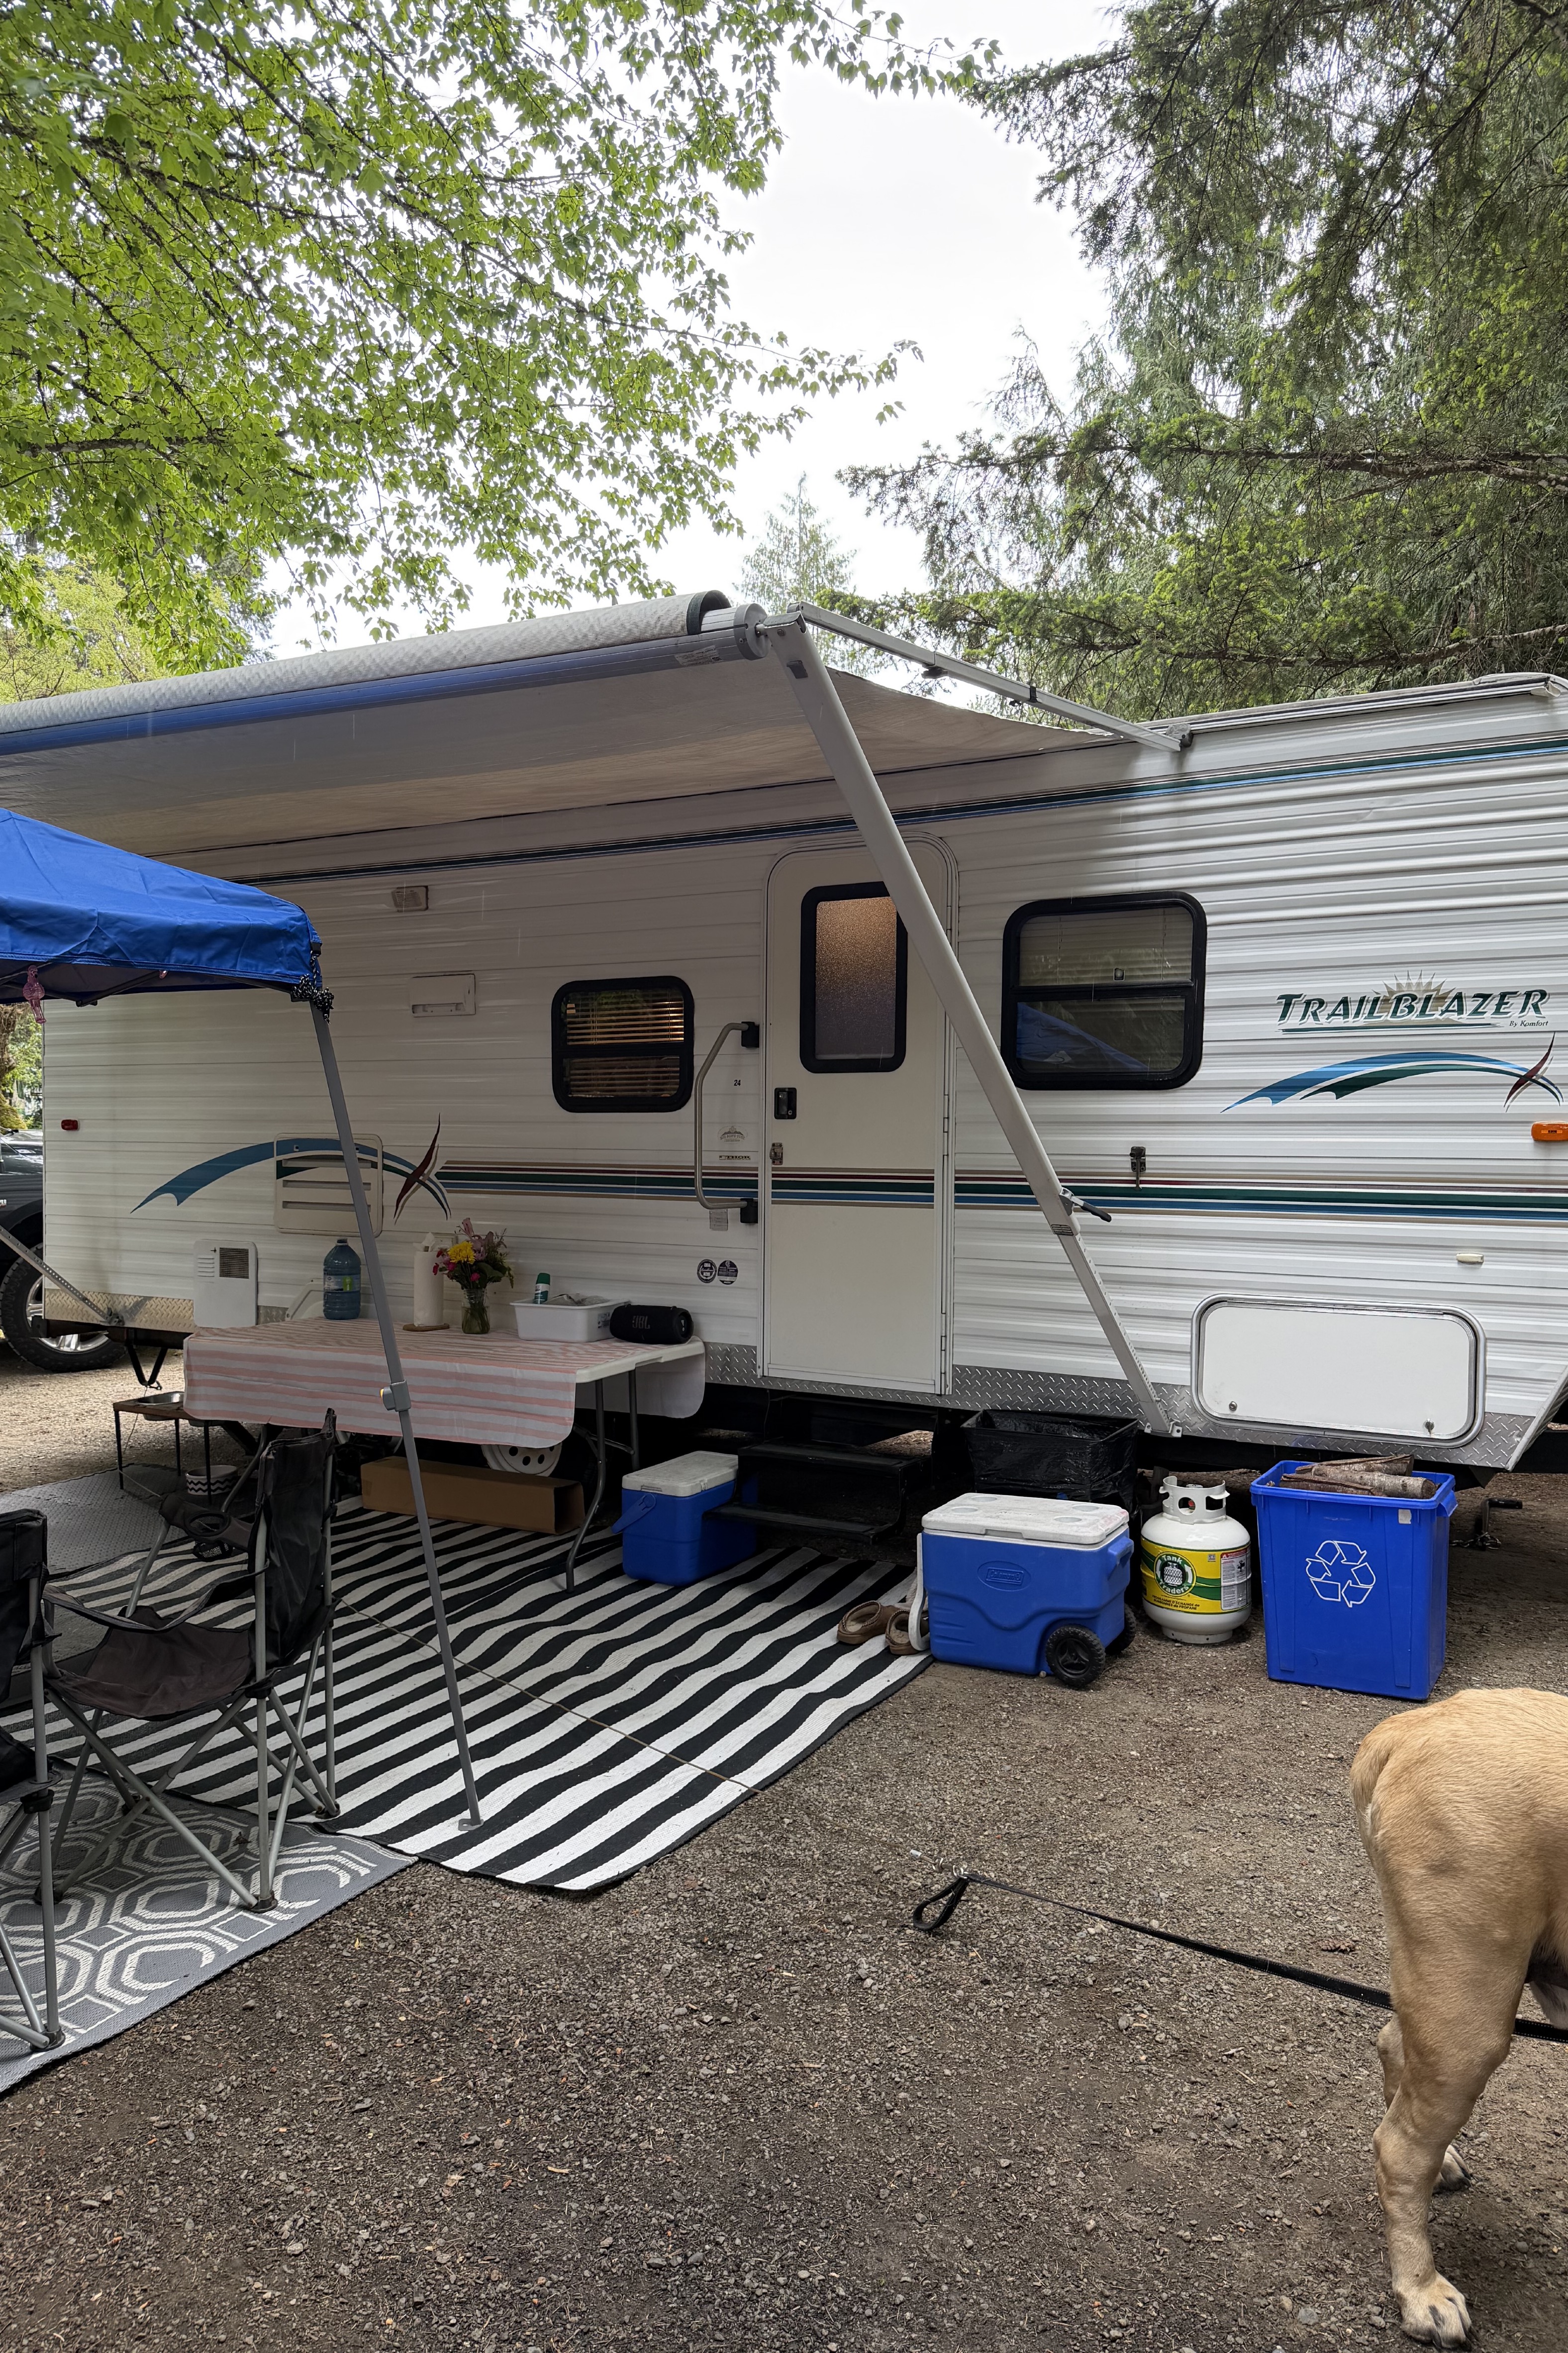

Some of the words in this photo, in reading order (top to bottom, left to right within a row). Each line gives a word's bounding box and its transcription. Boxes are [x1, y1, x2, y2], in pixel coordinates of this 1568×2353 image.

[1276, 989, 1549, 1025] TRAILBLAZER
[632, 1315, 650, 1329] JBL
[1162, 1555, 1182, 1564] Tank
[1159, 1579, 1189, 1594] Traders
